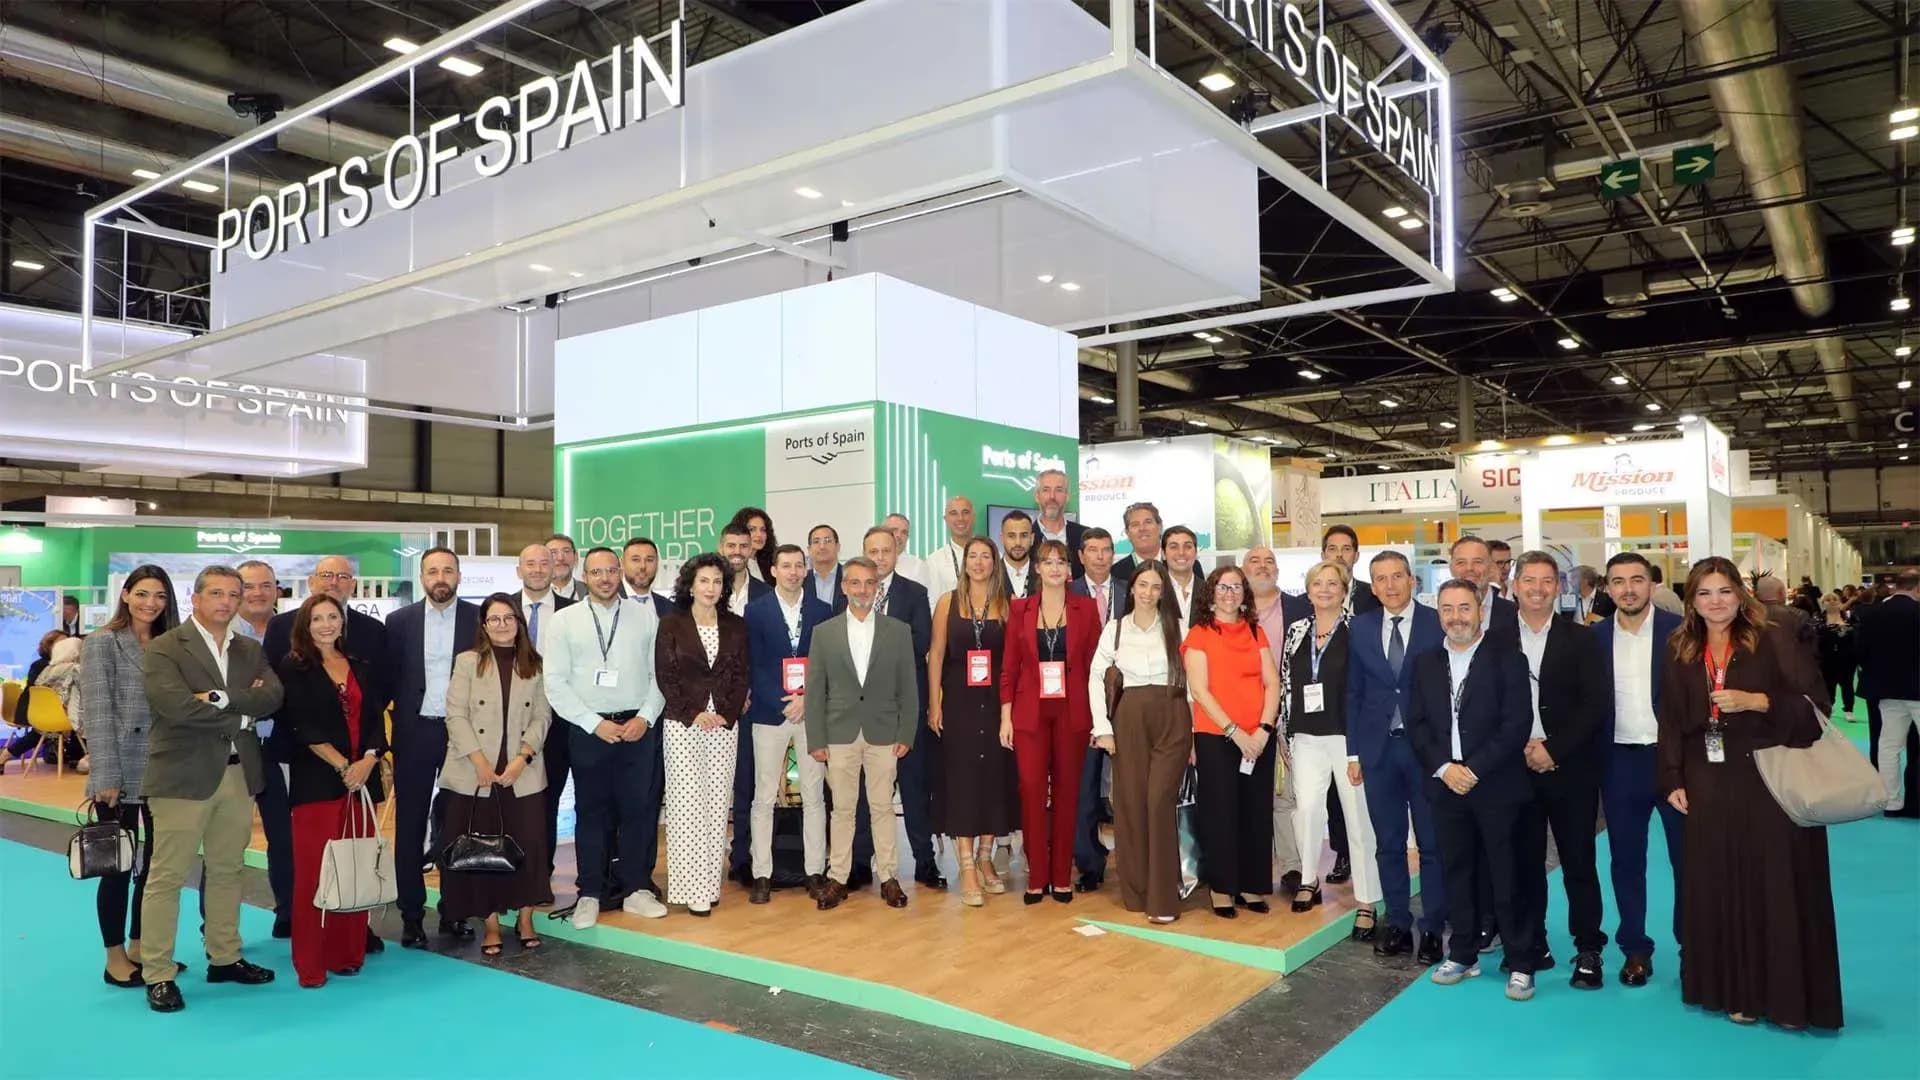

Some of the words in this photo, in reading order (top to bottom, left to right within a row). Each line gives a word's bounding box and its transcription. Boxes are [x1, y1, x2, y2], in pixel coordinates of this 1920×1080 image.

[1316, 35, 1361, 116] OF
[1364, 80, 1440, 196] SPAIN
[217, 156, 372, 273] PORTS
[383, 112, 463, 210] OF
[474, 18, 686, 178] SPAIN
[169, 376, 230, 409] OF
[237, 384, 348, 424] SPAIN
[1894, 411, 1915, 432] C
[785, 436, 814, 450] Ports
[816, 432, 829, 446] of
[832, 429, 865, 446] Spain
[982, 445, 1016, 469] Ports
[1017, 450, 1032, 470] of
[1369, 477, 1457, 502] ITALIA
[1482, 467, 1521, 488] SIC
[1572, 469, 1675, 492] Mission
[197, 531, 230, 543] Ports
[231, 531, 247, 543] of
[247, 532, 281, 545] Spain
[576, 507, 716, 545] TOGETHER
